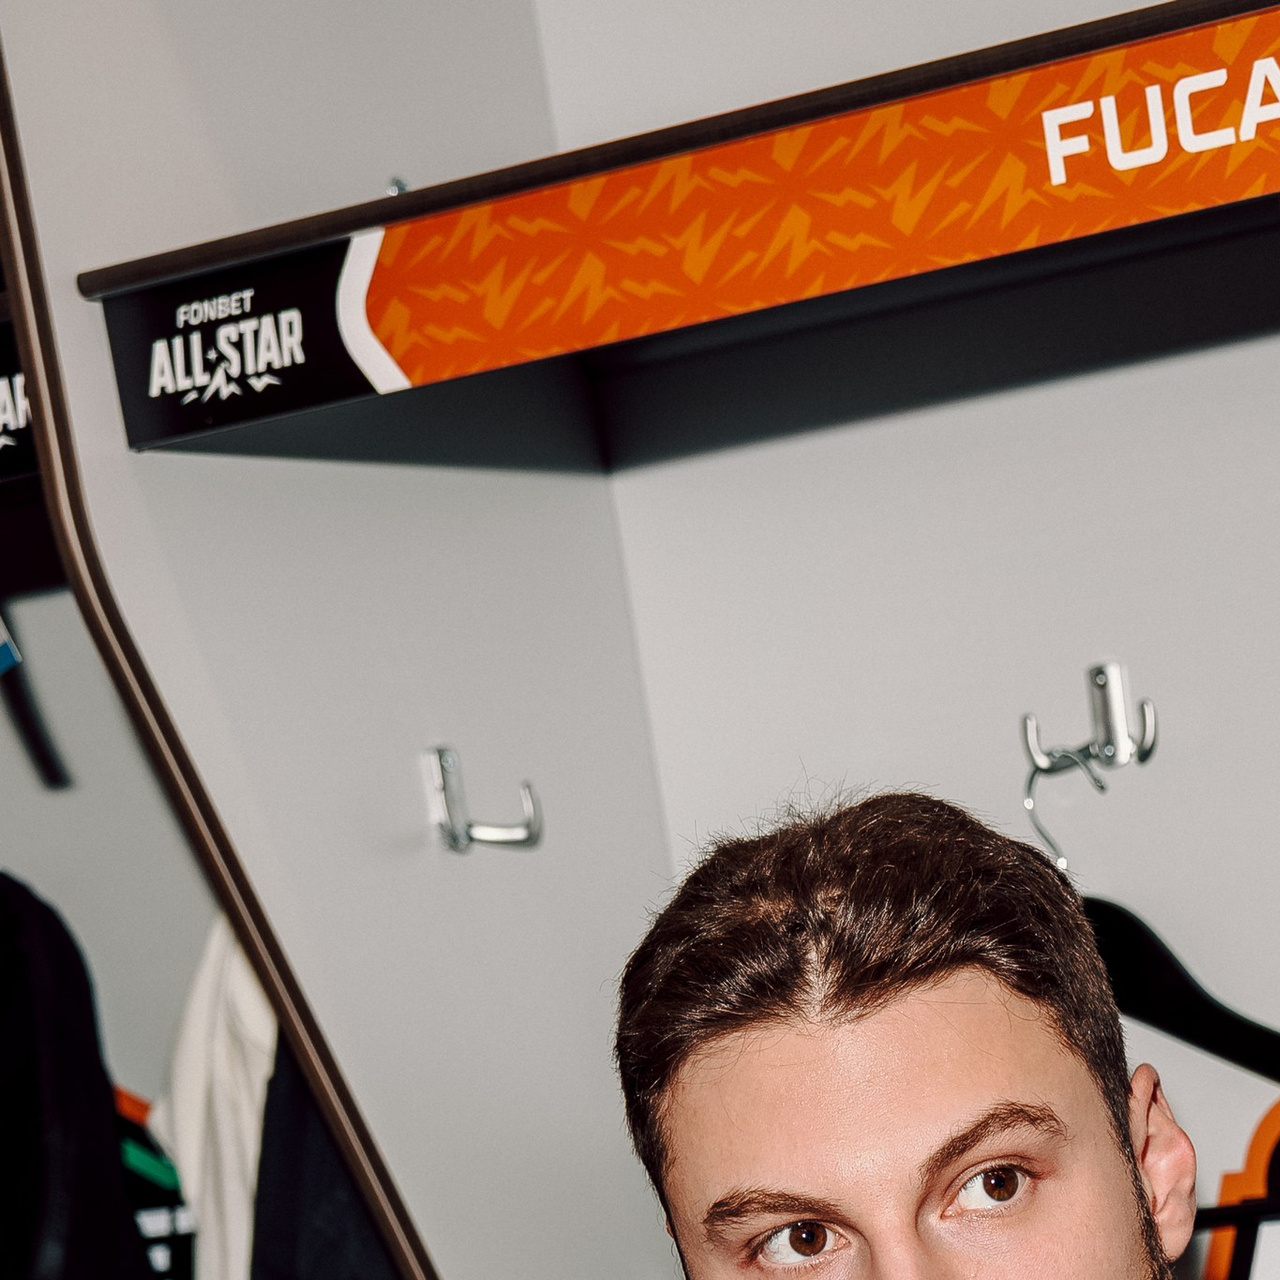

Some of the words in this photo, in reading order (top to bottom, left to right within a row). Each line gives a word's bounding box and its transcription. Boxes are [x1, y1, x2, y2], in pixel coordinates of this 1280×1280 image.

[176, 289, 255, 330] FONBET
[148, 331, 211, 398] ALL
[215, 308, 306, 379] STAR
